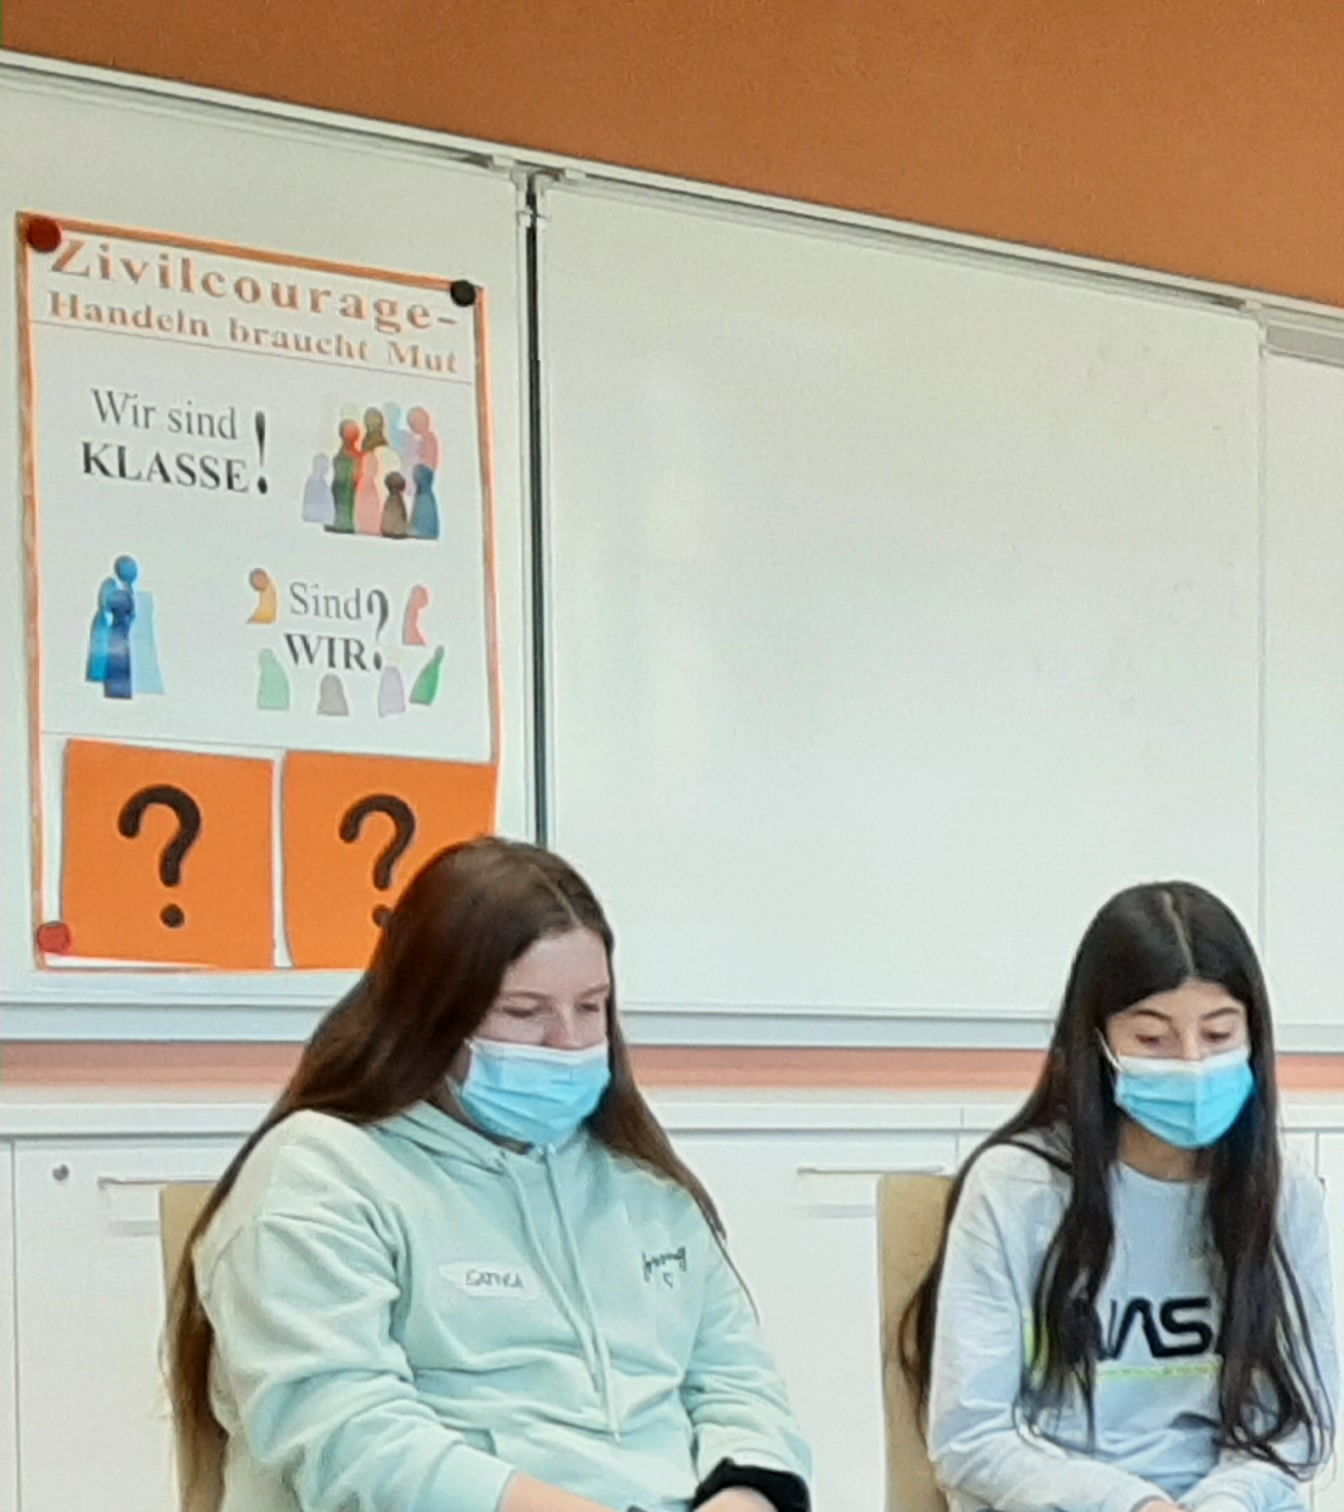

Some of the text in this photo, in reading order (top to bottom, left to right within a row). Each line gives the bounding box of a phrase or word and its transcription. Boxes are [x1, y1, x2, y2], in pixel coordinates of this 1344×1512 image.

[50, 239, 459, 334] Zivilcourage-
[49, 290, 458, 373] Handeln braucht Mut
[90, 388, 238, 440] Wir sind
[288, 582, 362, 621] Sind
